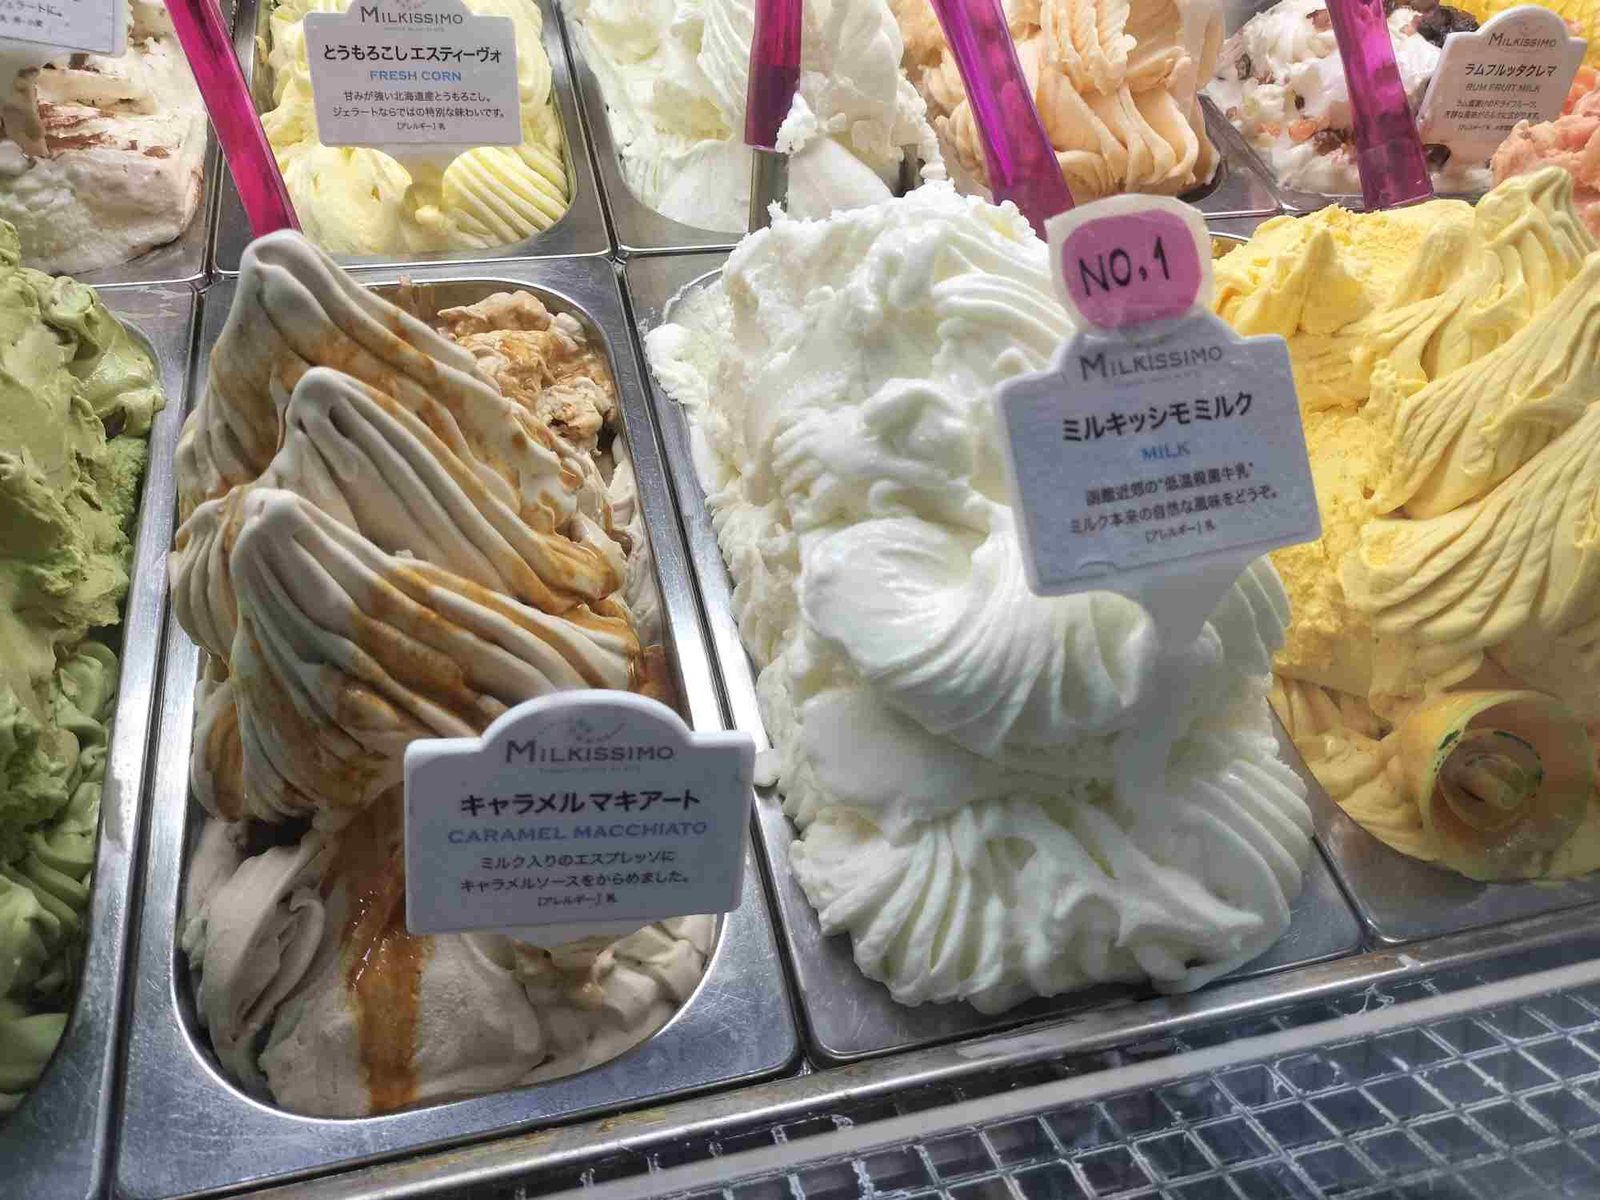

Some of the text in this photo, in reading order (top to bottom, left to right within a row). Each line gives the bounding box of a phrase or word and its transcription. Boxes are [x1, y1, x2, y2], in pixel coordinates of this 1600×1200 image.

[361, 6, 463, 25] MILKISSIMO
[1488, 33, 1557, 48] MILKISSIMO
[370, 70, 462, 81] FRESH CORN
[1465, 64, 1557, 78] ラムフルッタクレマ
[1466, 83, 1488, 92] RUM
[1488, 83, 1518, 92] FRUIT
[1079, 346, 1223, 381] MILKISSIMO
[1062, 391, 1253, 442] ミルキッシモミルク
[1141, 442, 1190, 462] MILK
[505, 740, 674, 763] MILKISSIMO
[448, 820, 707, 844] CARAMEL MACCHIATO
[480, 850, 675, 870] ミルク入りのエスプレッソに
[460, 870, 689, 893] キャラメルソースをからめました。
